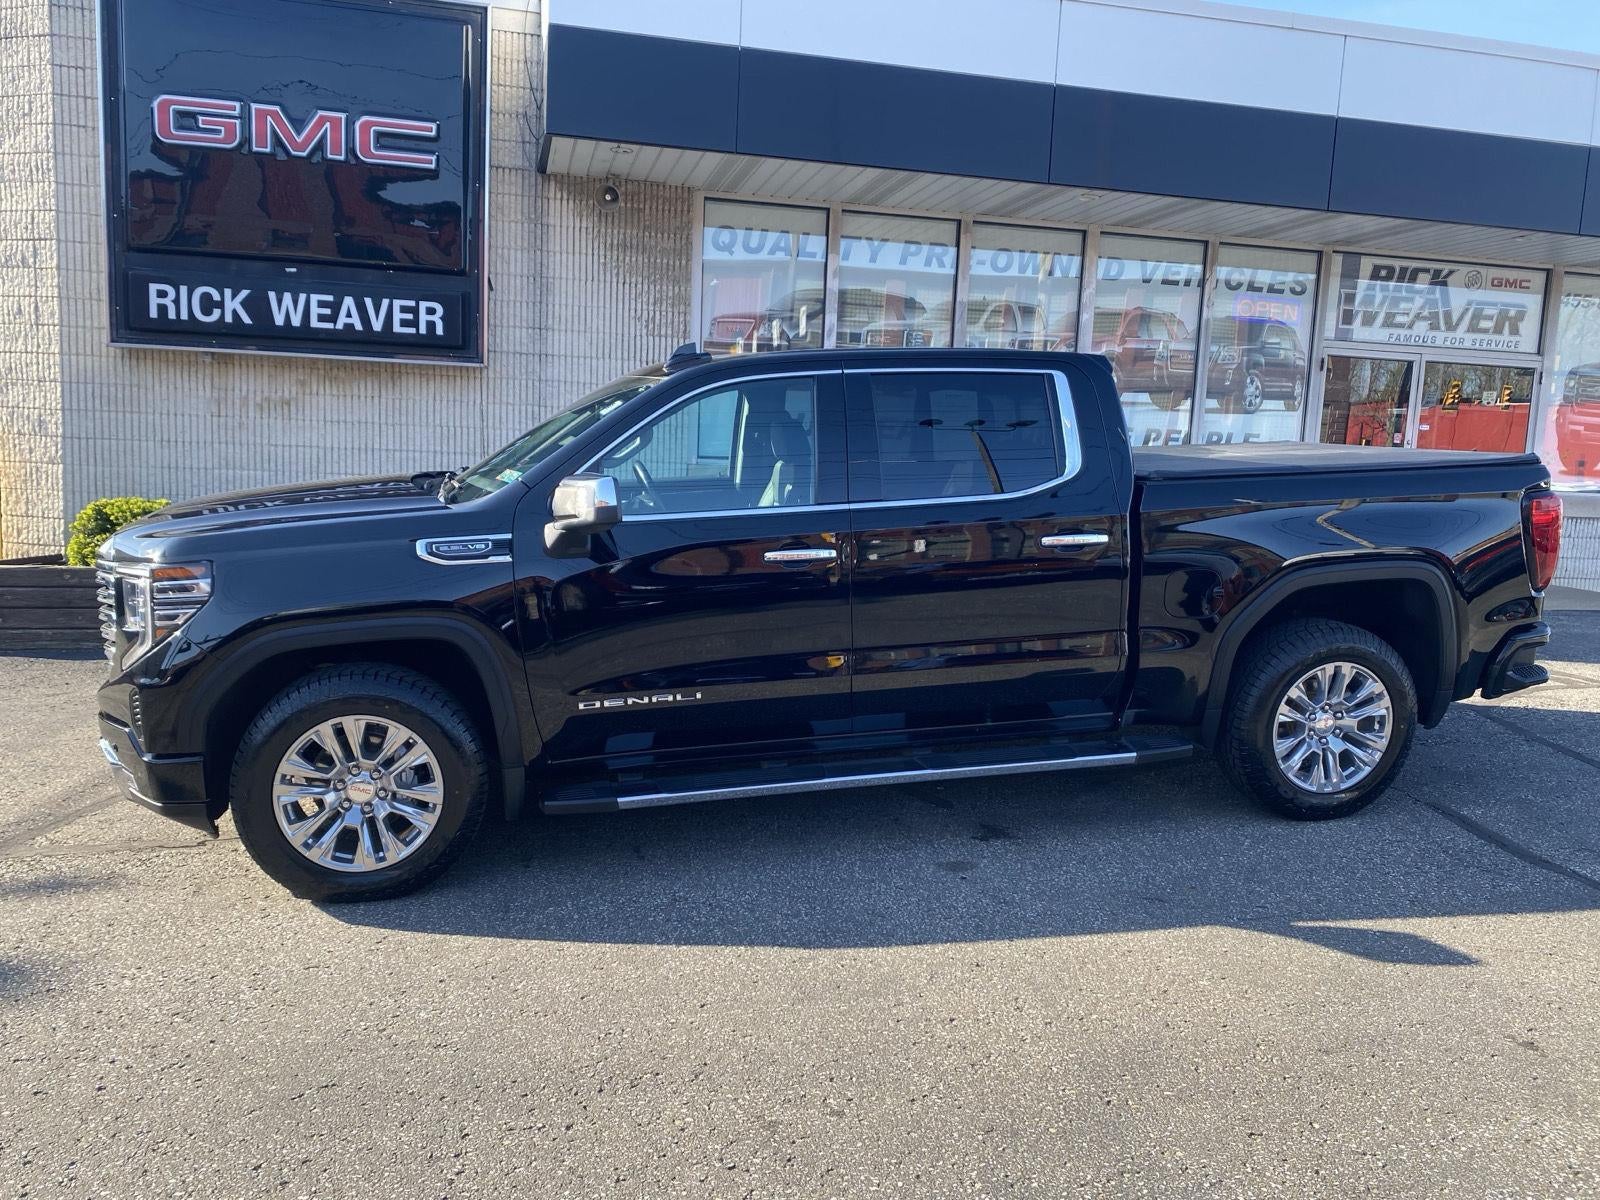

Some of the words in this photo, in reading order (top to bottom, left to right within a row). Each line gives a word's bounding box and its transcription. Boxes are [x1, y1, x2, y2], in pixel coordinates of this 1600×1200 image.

[150, 94, 439, 170] GMC
[711, 225, 890, 264] QUALTY
[898, 239, 1126, 281] PR-OWND
[1140, 259, 1308, 296] VEHCLES
[1490, 276, 1532, 290] GMC
[148, 282, 253, 326] RICK
[268, 291, 444, 337] WEAVER
[1237, 299, 1298, 321] OPEN
[1349, 295, 1529, 338] WEAVER
[1387, 333, 1437, 345] FAMOUS
[1442, 336, 1465, 347] FOR
[1471, 338, 1521, 349] SERVICE
[1141, 427, 1261, 447] PEPL
[578, 691, 702, 710] DENALI
[350, 784, 372, 796] GMC
